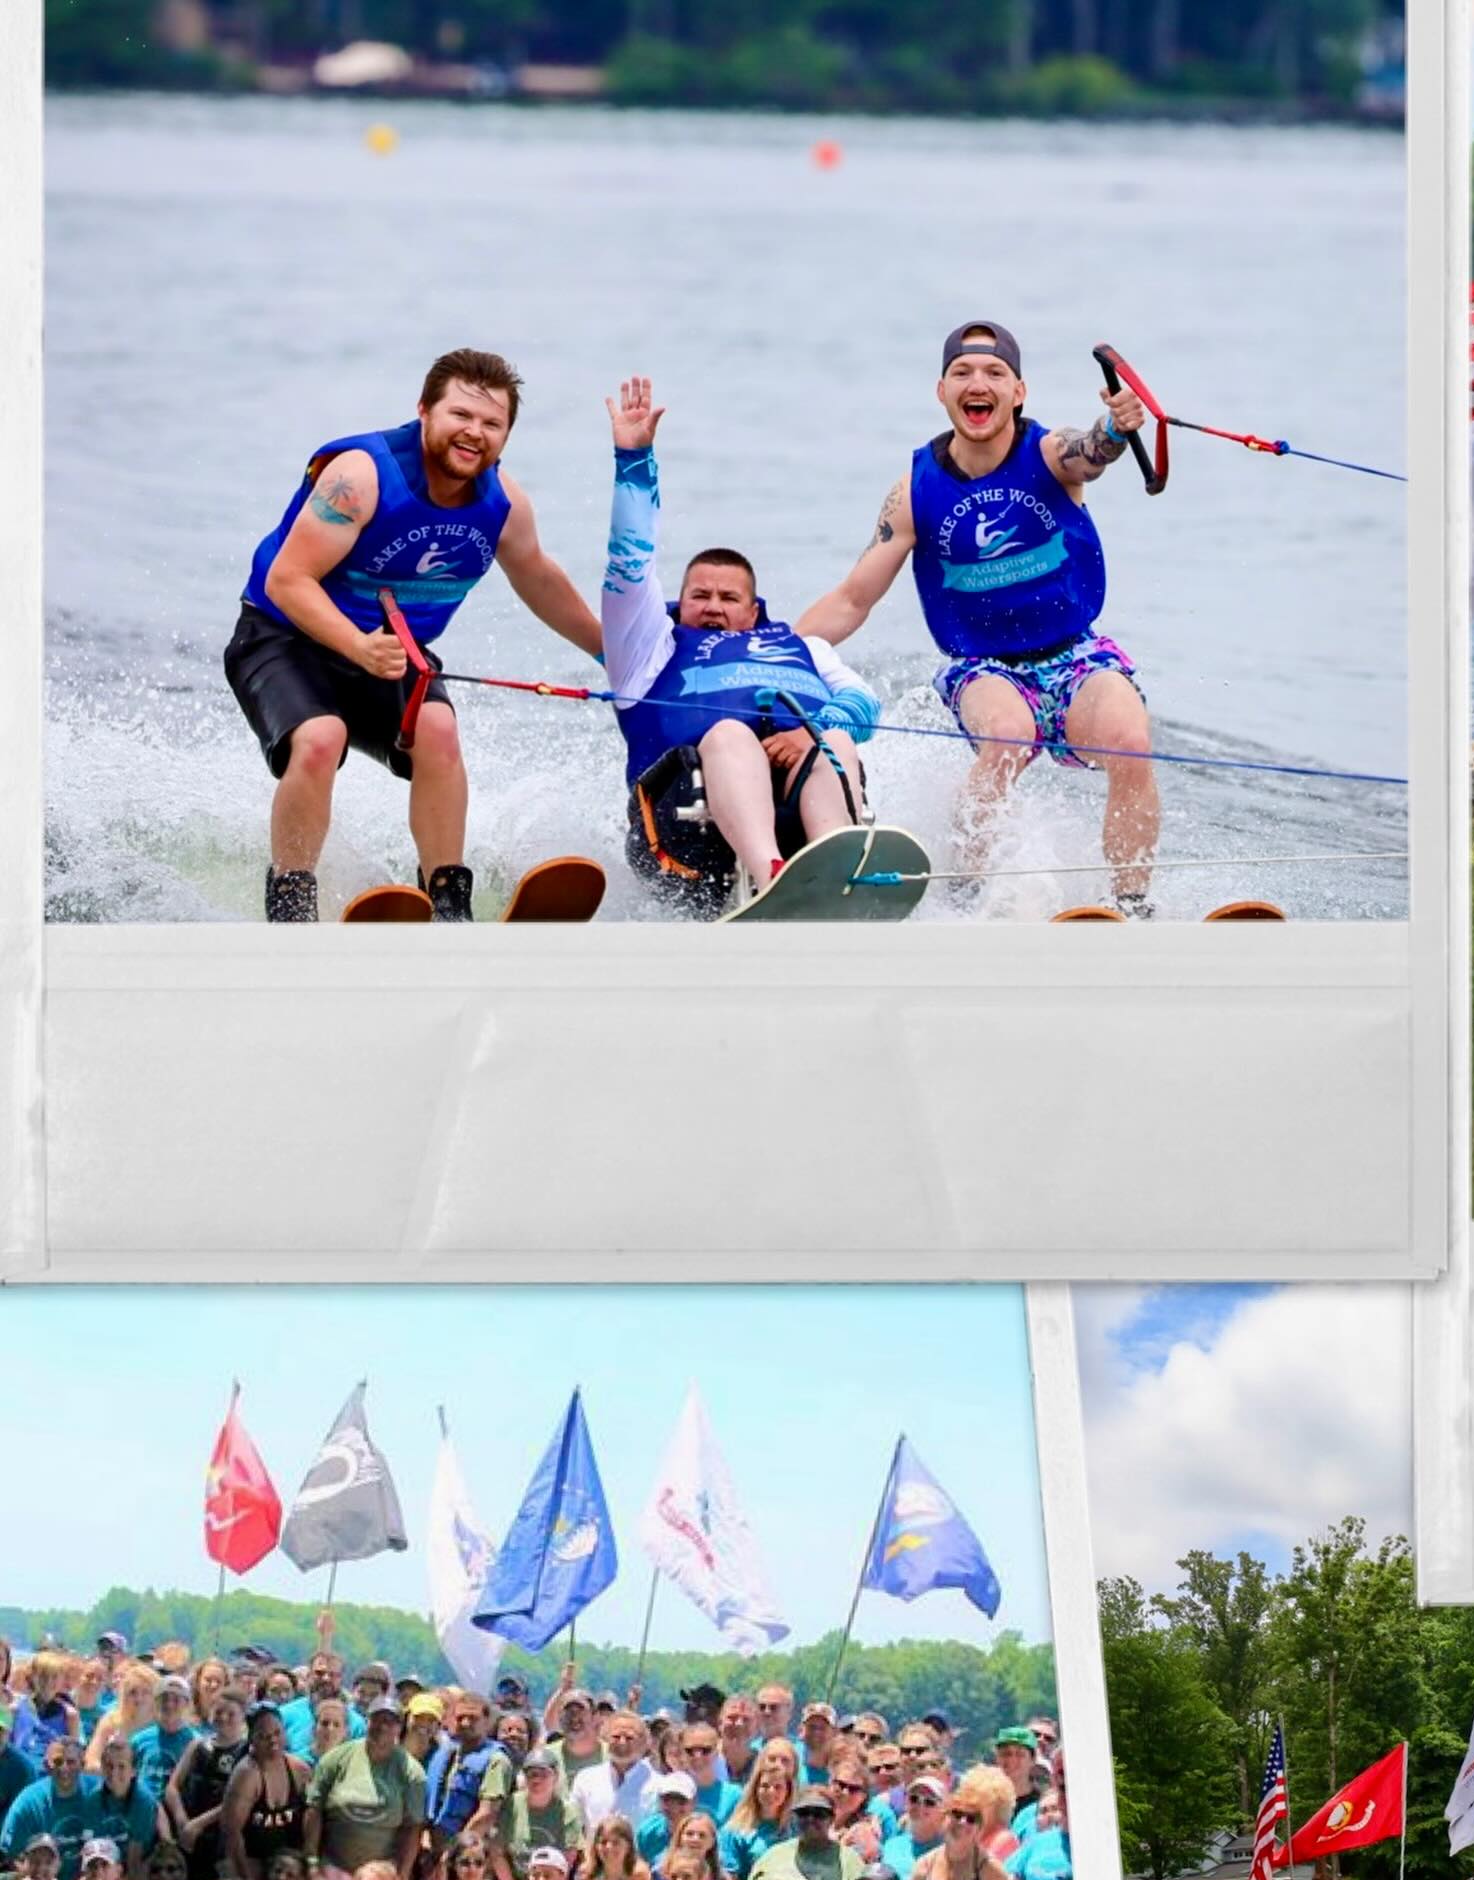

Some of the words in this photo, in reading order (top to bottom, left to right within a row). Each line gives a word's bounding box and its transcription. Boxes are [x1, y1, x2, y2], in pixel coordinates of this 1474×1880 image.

[939, 516, 957, 556] LAKE
[953, 497, 973, 517] OF
[971, 488, 1004, 505] THE
[1009, 488, 1057, 531] WOODS
[365, 538, 407, 574] LAKE
[408, 526, 431, 542] OF
[435, 524, 468, 537] THE
[971, 554, 1035, 576] Adaptive
[963, 561, 1048, 588] Watersports
